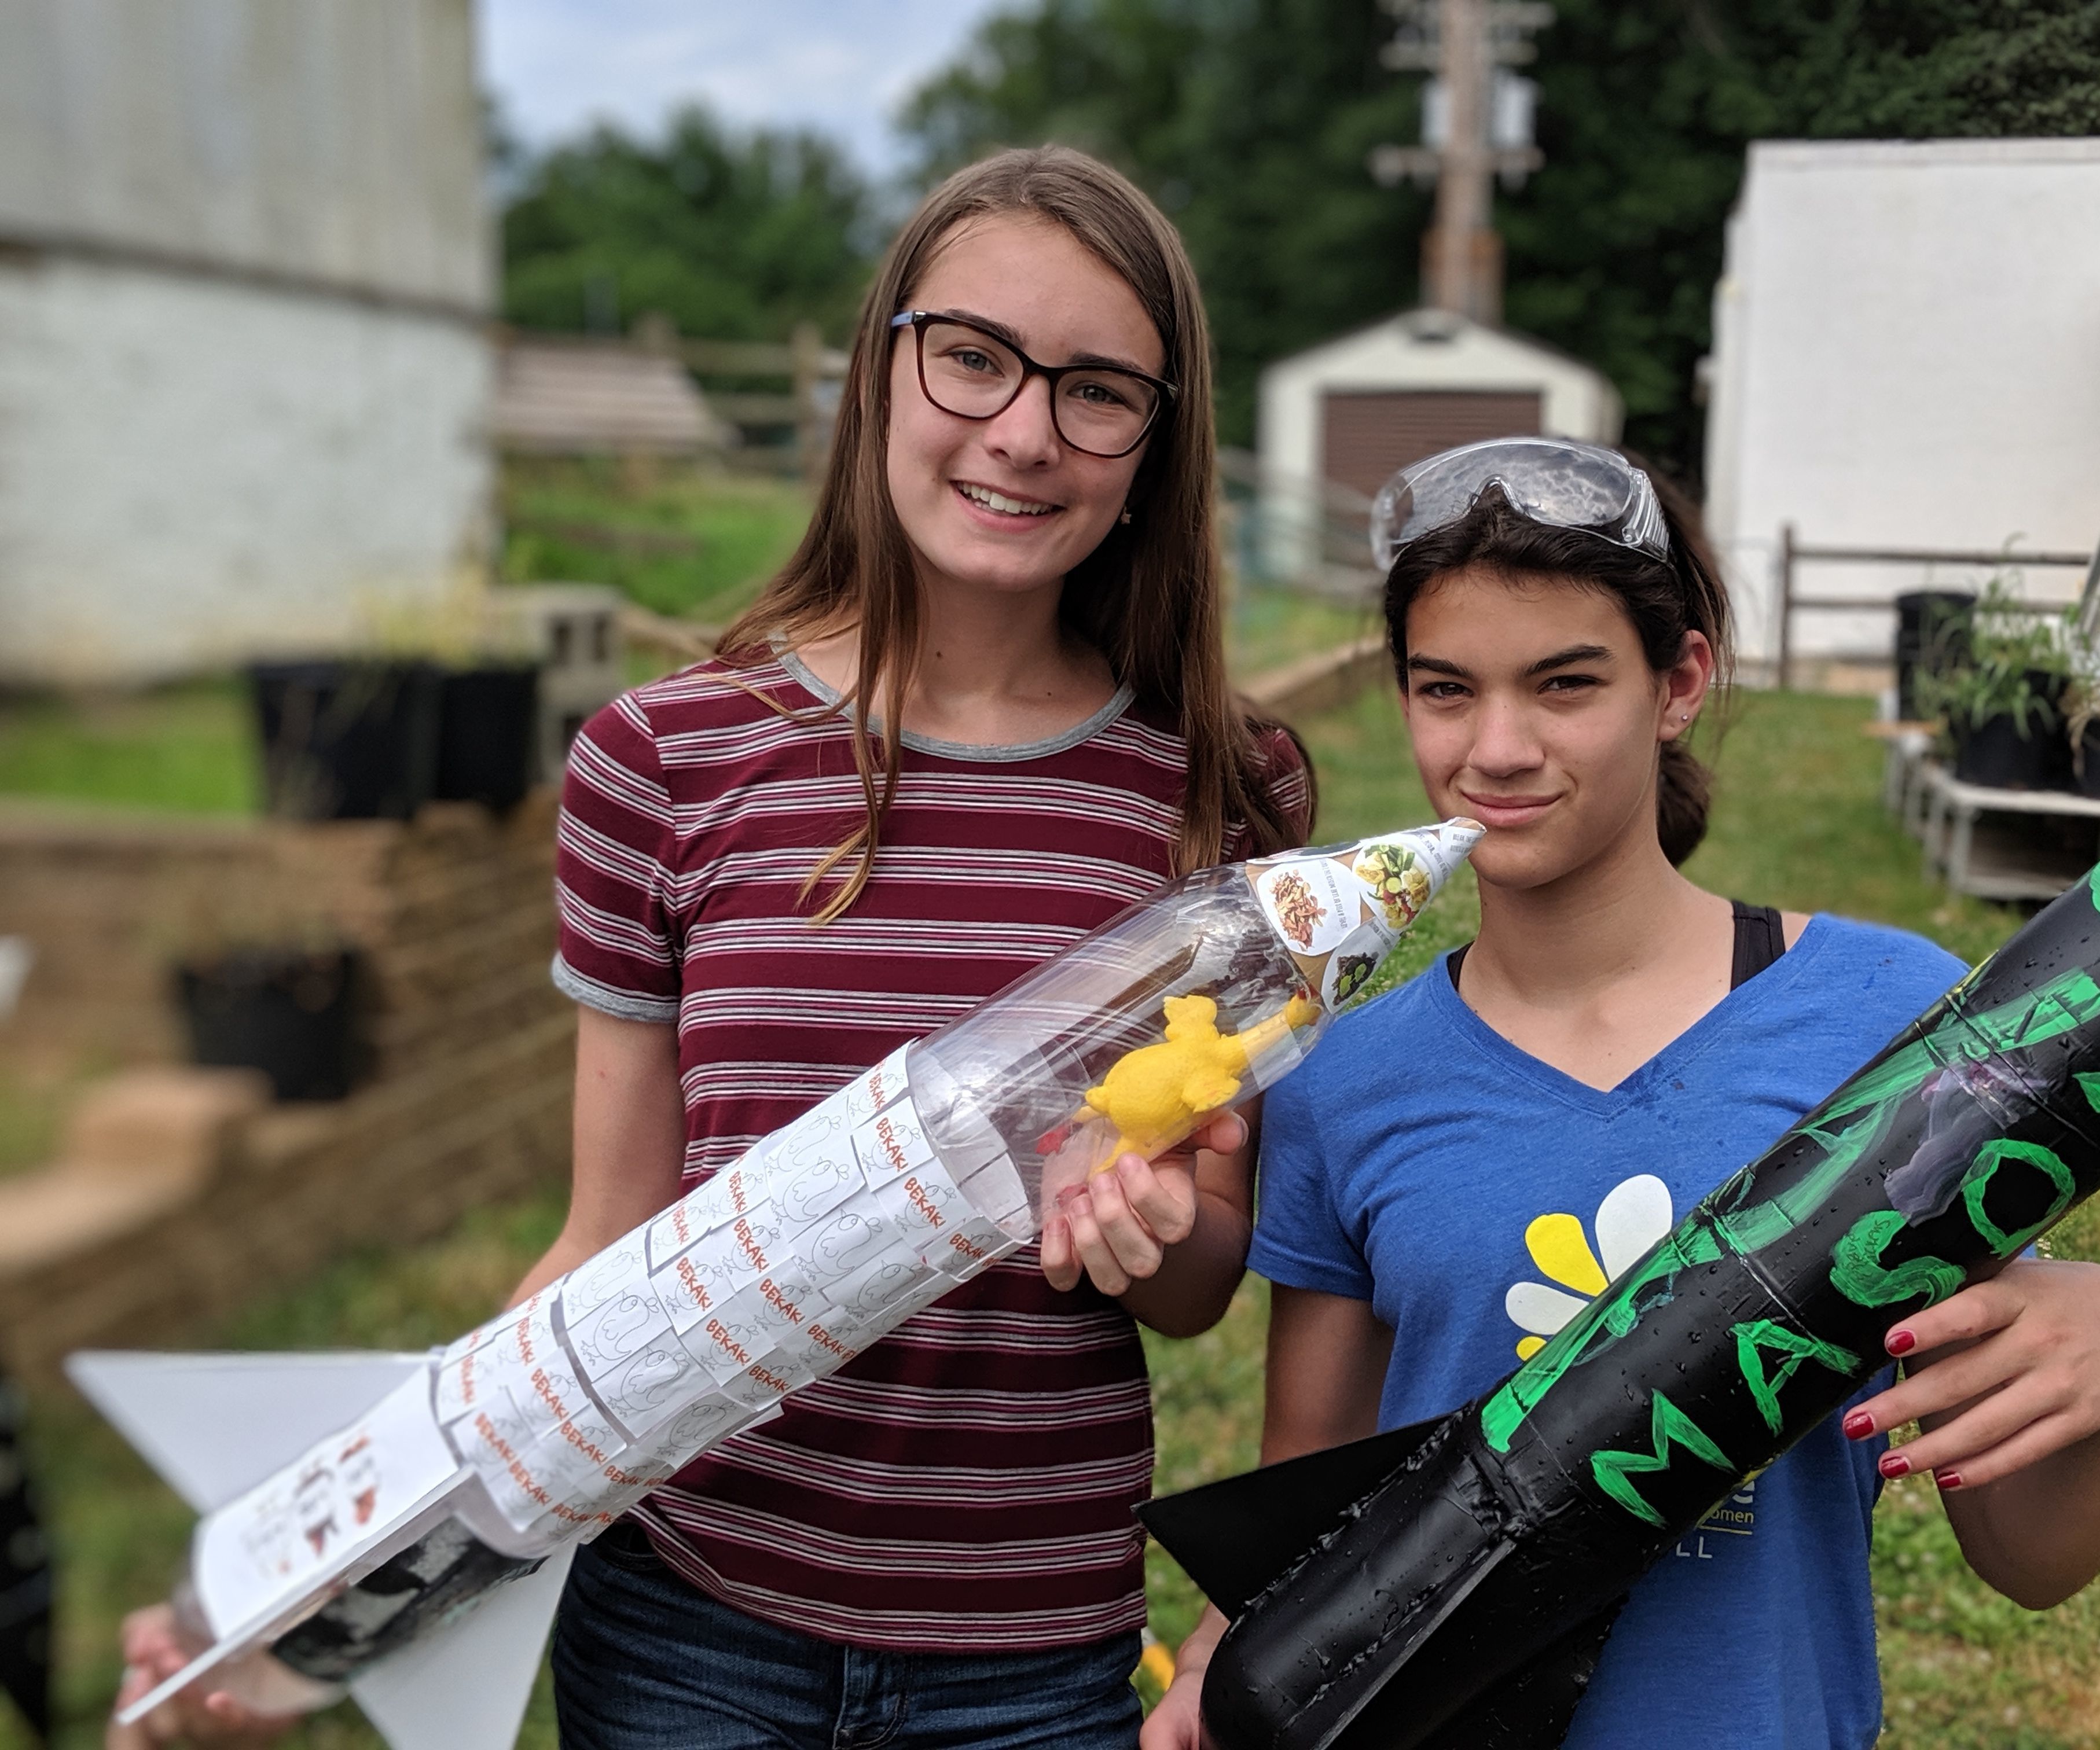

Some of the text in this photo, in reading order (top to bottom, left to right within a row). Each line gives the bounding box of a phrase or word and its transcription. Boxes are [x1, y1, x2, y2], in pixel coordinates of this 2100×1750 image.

[875, 1116, 909, 1173] BEKAK!
[904, 1176, 947, 1229] BEKAK!
[733, 1218, 769, 1273] BEKAK!
[676, 1256, 714, 1312] BEKAK!
[759, 1278, 805, 1325] BEKAK!
[705, 1318, 752, 1366] BEKAK!
[807, 1323, 850, 1355] BEKAK!
[530, 1368, 570, 1422] BEKAK!
[748, 1365, 792, 1394] BEKAK!
[560, 1421, 608, 1466] BEKAK!
[508, 1461, 553, 1506] BEKAK!
[1710, 1508, 1754, 1524] omen
[1675, 1535, 1713, 1559] LL
